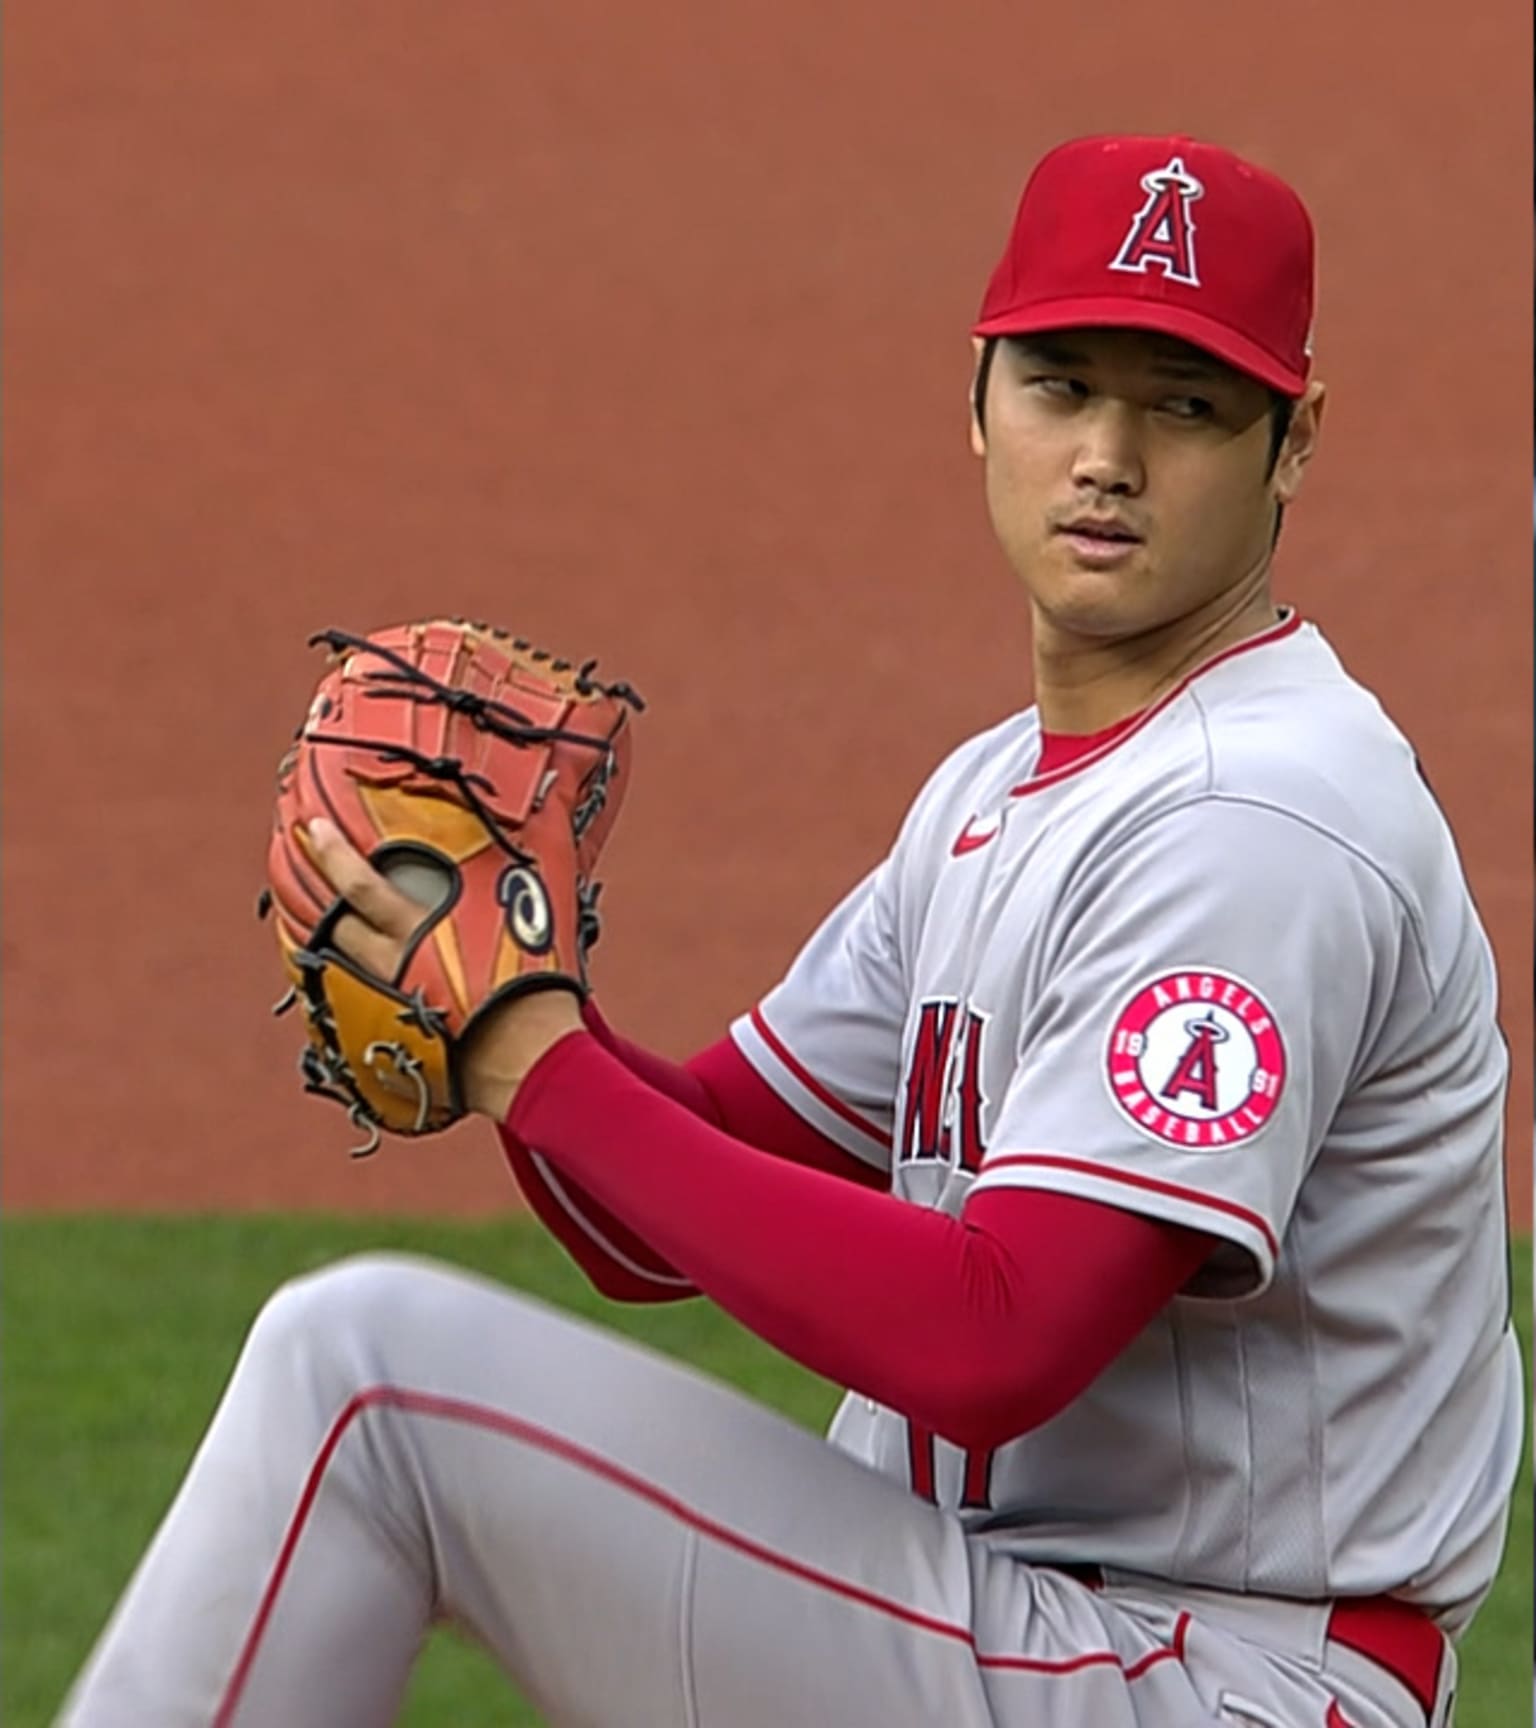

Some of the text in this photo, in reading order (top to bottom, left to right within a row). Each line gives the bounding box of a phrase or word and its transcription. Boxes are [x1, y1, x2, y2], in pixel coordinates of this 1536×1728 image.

[1108, 157, 1203, 288] A
[1152, 975, 1271, 1036] ANGELS
[1159, 1008, 1230, 1112] A
[1112, 1070, 1264, 1144] BASEBALL
